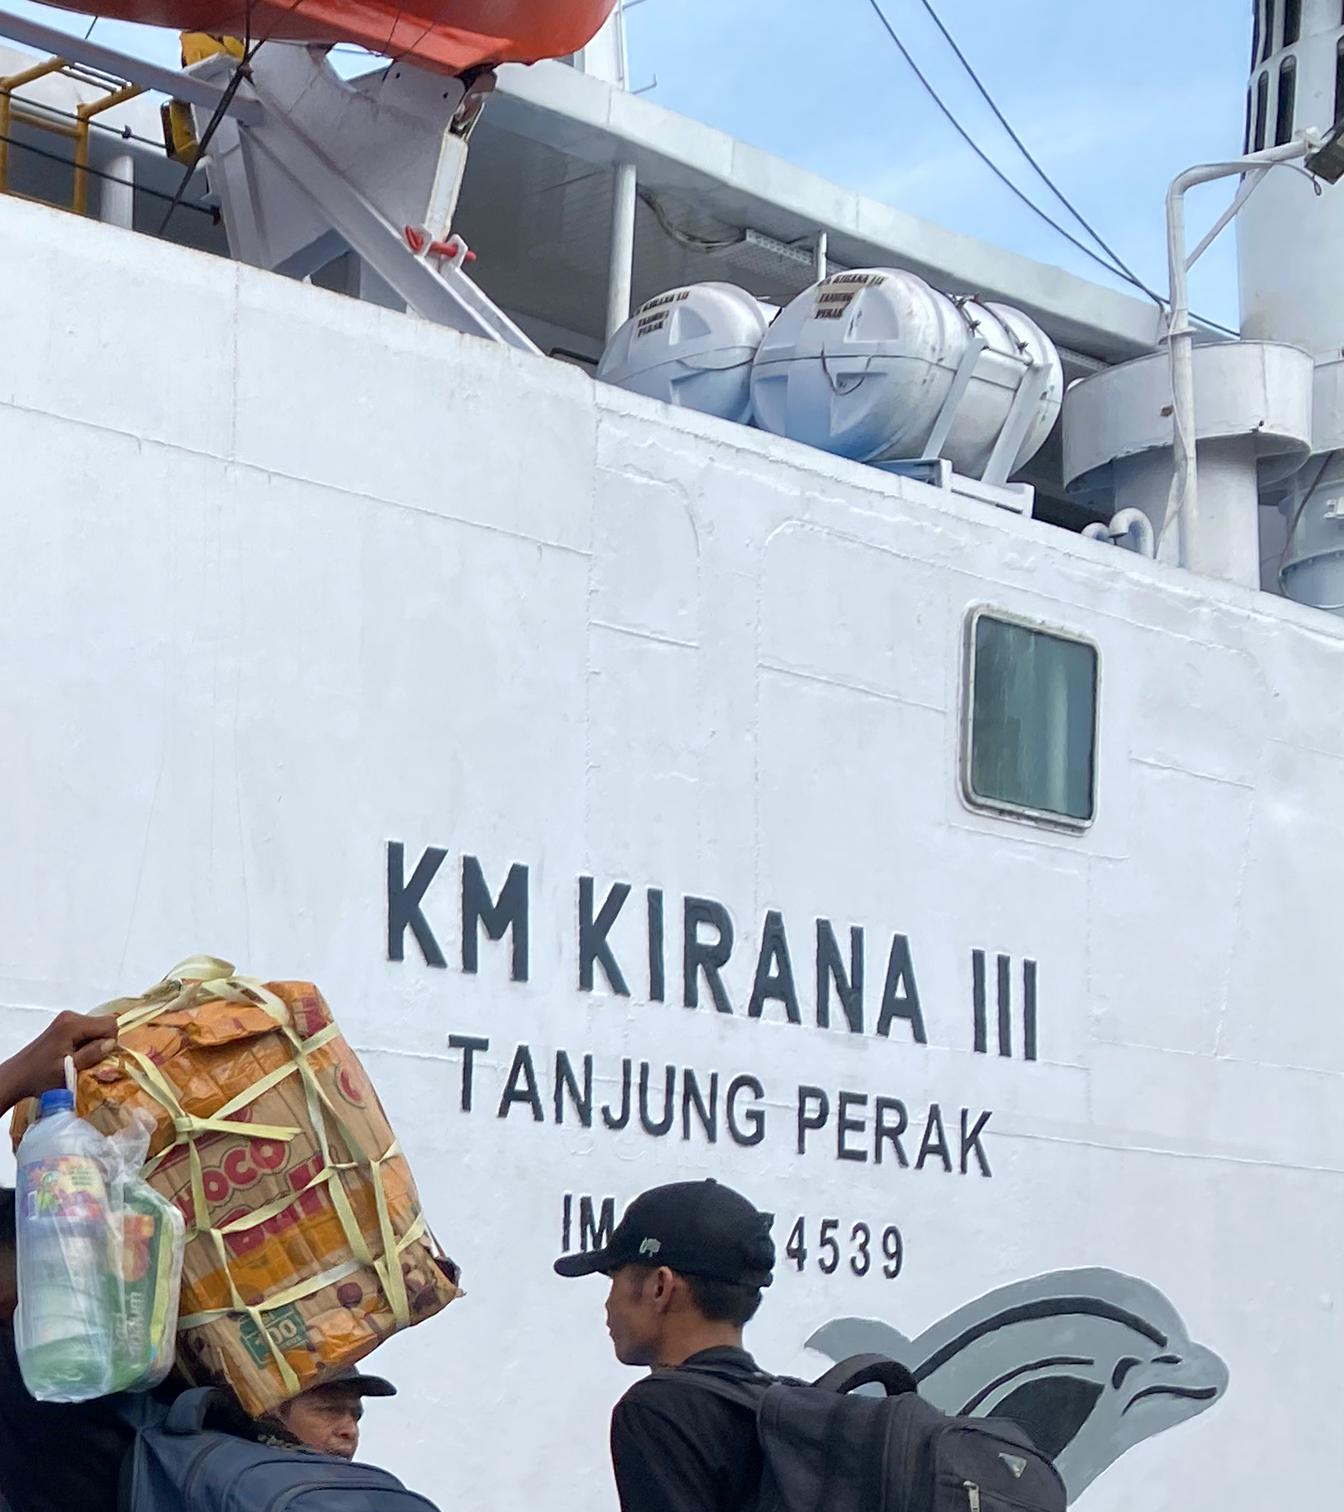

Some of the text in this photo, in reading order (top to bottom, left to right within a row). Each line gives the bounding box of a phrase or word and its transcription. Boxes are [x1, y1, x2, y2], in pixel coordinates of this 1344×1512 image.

[387, 840, 1038, 1061] KM KIRANA III
[448, 1034, 994, 1178] TANJUNG PERAK
[561, 1193, 616, 1253] IM
